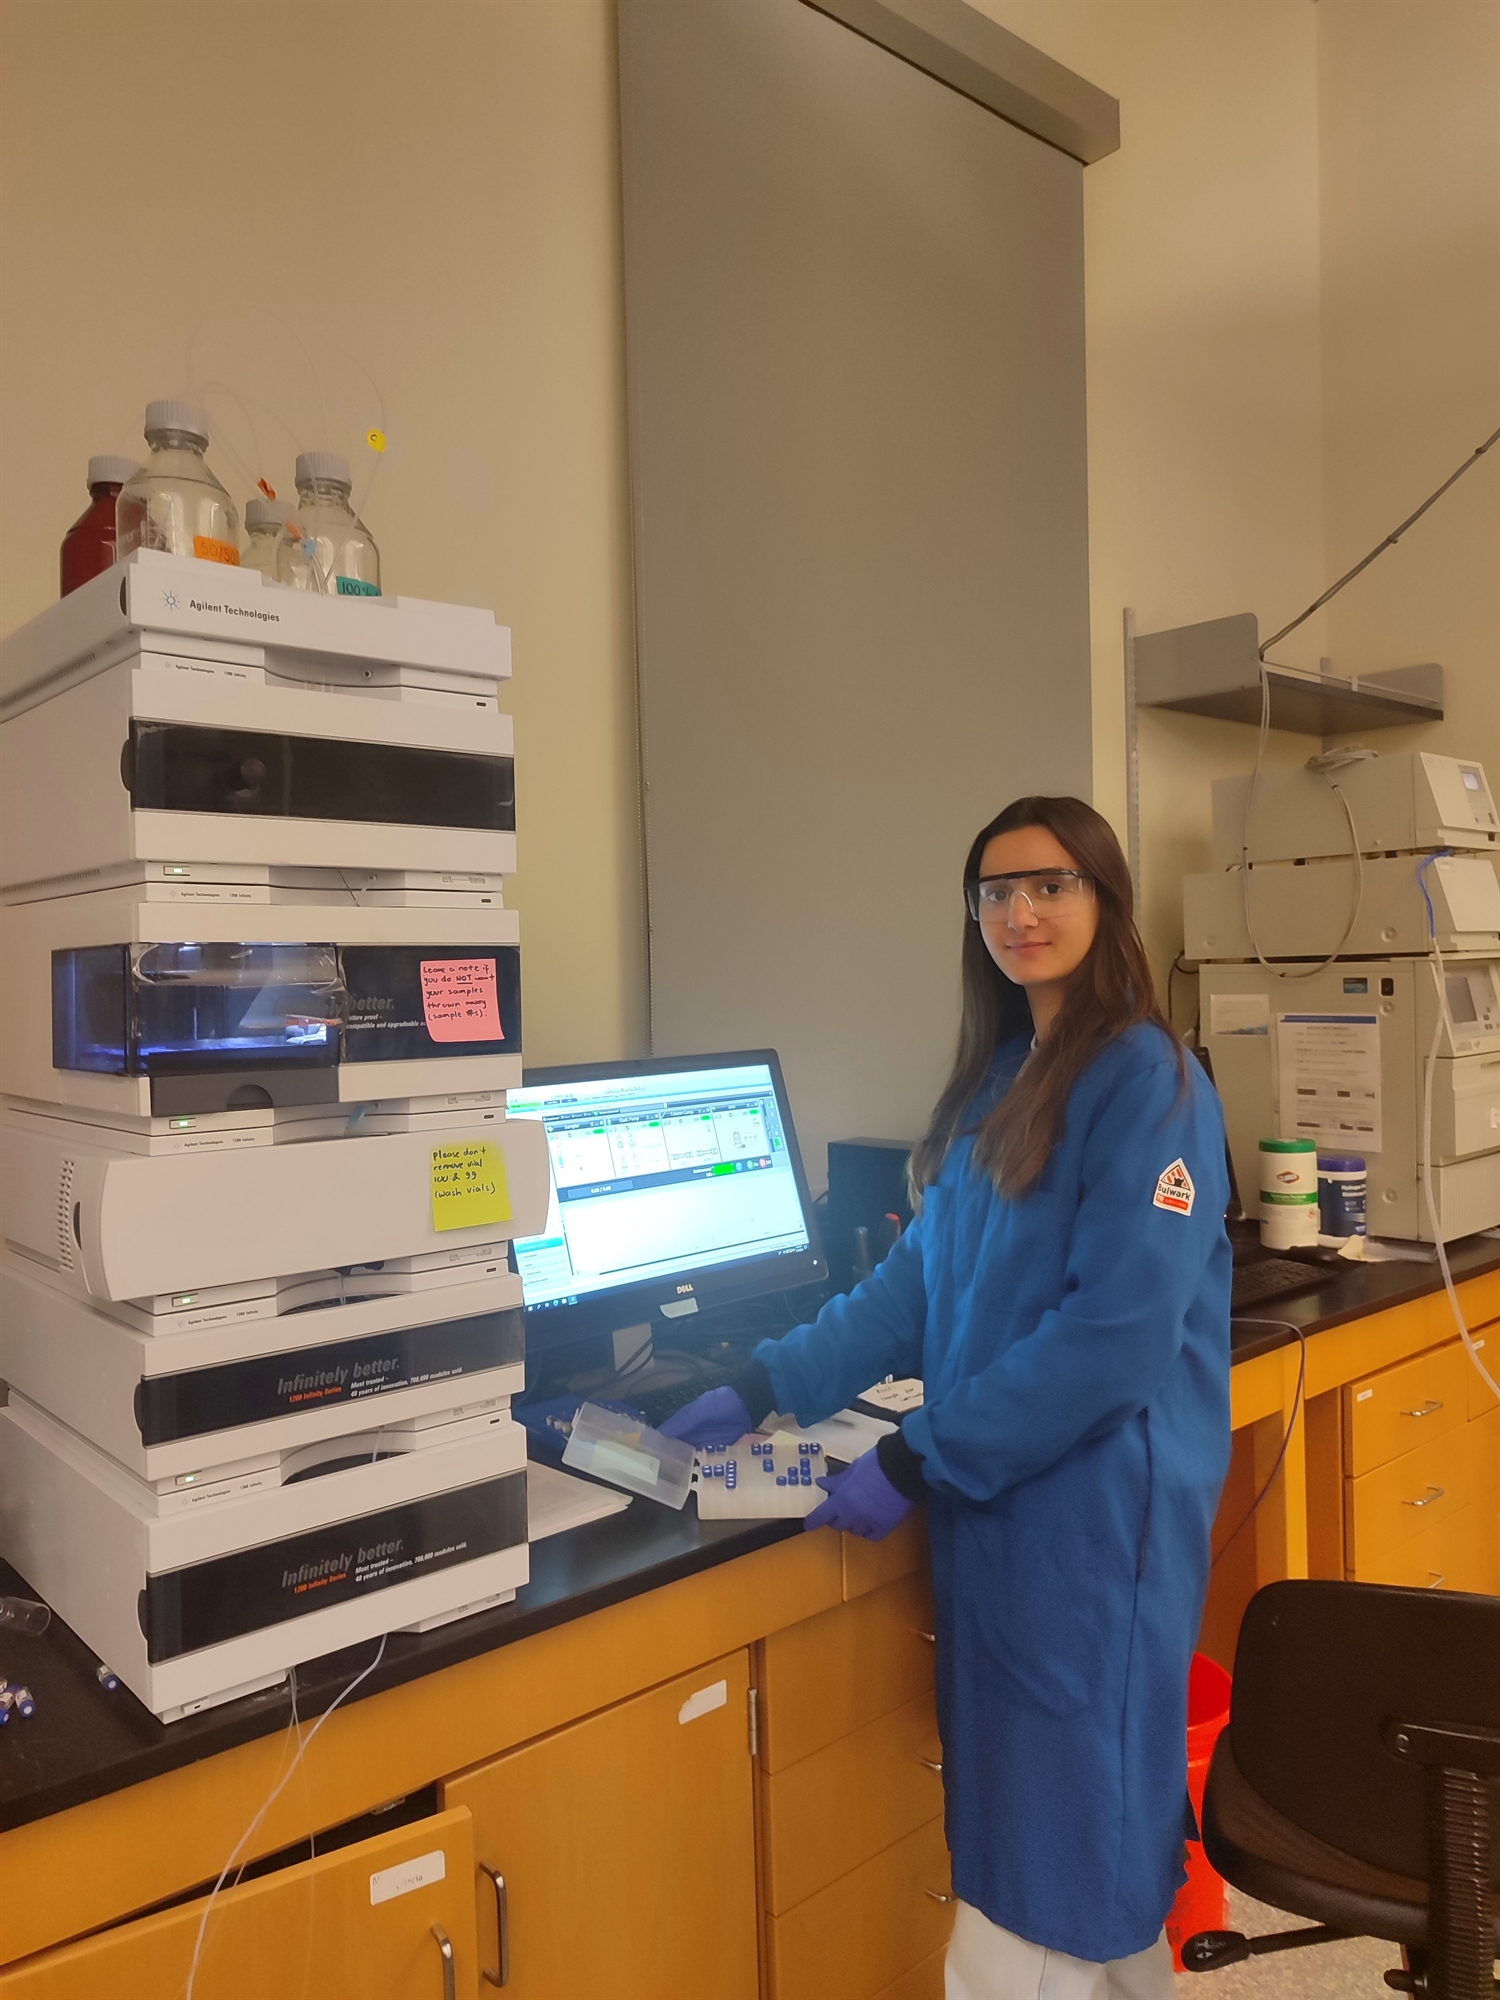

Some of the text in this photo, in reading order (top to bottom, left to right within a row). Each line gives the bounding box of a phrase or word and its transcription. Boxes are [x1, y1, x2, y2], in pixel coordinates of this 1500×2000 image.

[190, 600, 280, 622] Agilent Technologies
[458, 964, 480, 972] note
[482, 964, 490, 974] if
[423, 976, 438, 987] you
[456, 974, 472, 983] NOT
[425, 987, 484, 999] your samples
[364, 1013, 379, 1022] proof
[428, 1011, 462, 1021] (sample
[346, 1020, 375, 1030] compatible
[376, 1020, 387, 1028] and
[463, 1146, 486, 1156] don't
[433, 1158, 483, 1171] remove vial
[452, 1172, 461, 1181] &
[434, 1181, 496, 1198] (wash vials)
[1157, 1184, 1191, 1201] Bulwark
[676, 1284, 694, 1294] DELL
[277, 1357, 400, 1395] Infinitely better.
[350, 1381, 365, 1389] Most
[365, 1375, 385, 1386] trusted
[350, 1390, 358, 1398] 40
[358, 1387, 374, 1397] years
[374, 1383, 381, 1392] of
[430, 1369, 451, 1380] modules
[303, 1389, 323, 1400] Infinity
[324, 1386, 343, 1395] Series
[281, 1539, 404, 1588] Infinitely better.
[354, 1574, 362, 1583] 40
[363, 1570, 378, 1582] years
[378, 1567, 385, 1576] of
[434, 1547, 455, 1558] modules
[354, 1565, 370, 1574] Most
[370, 1559, 389, 1570] trusted
[308, 1580, 328, 1591] Infinity
[328, 1572, 347, 1584] Series
